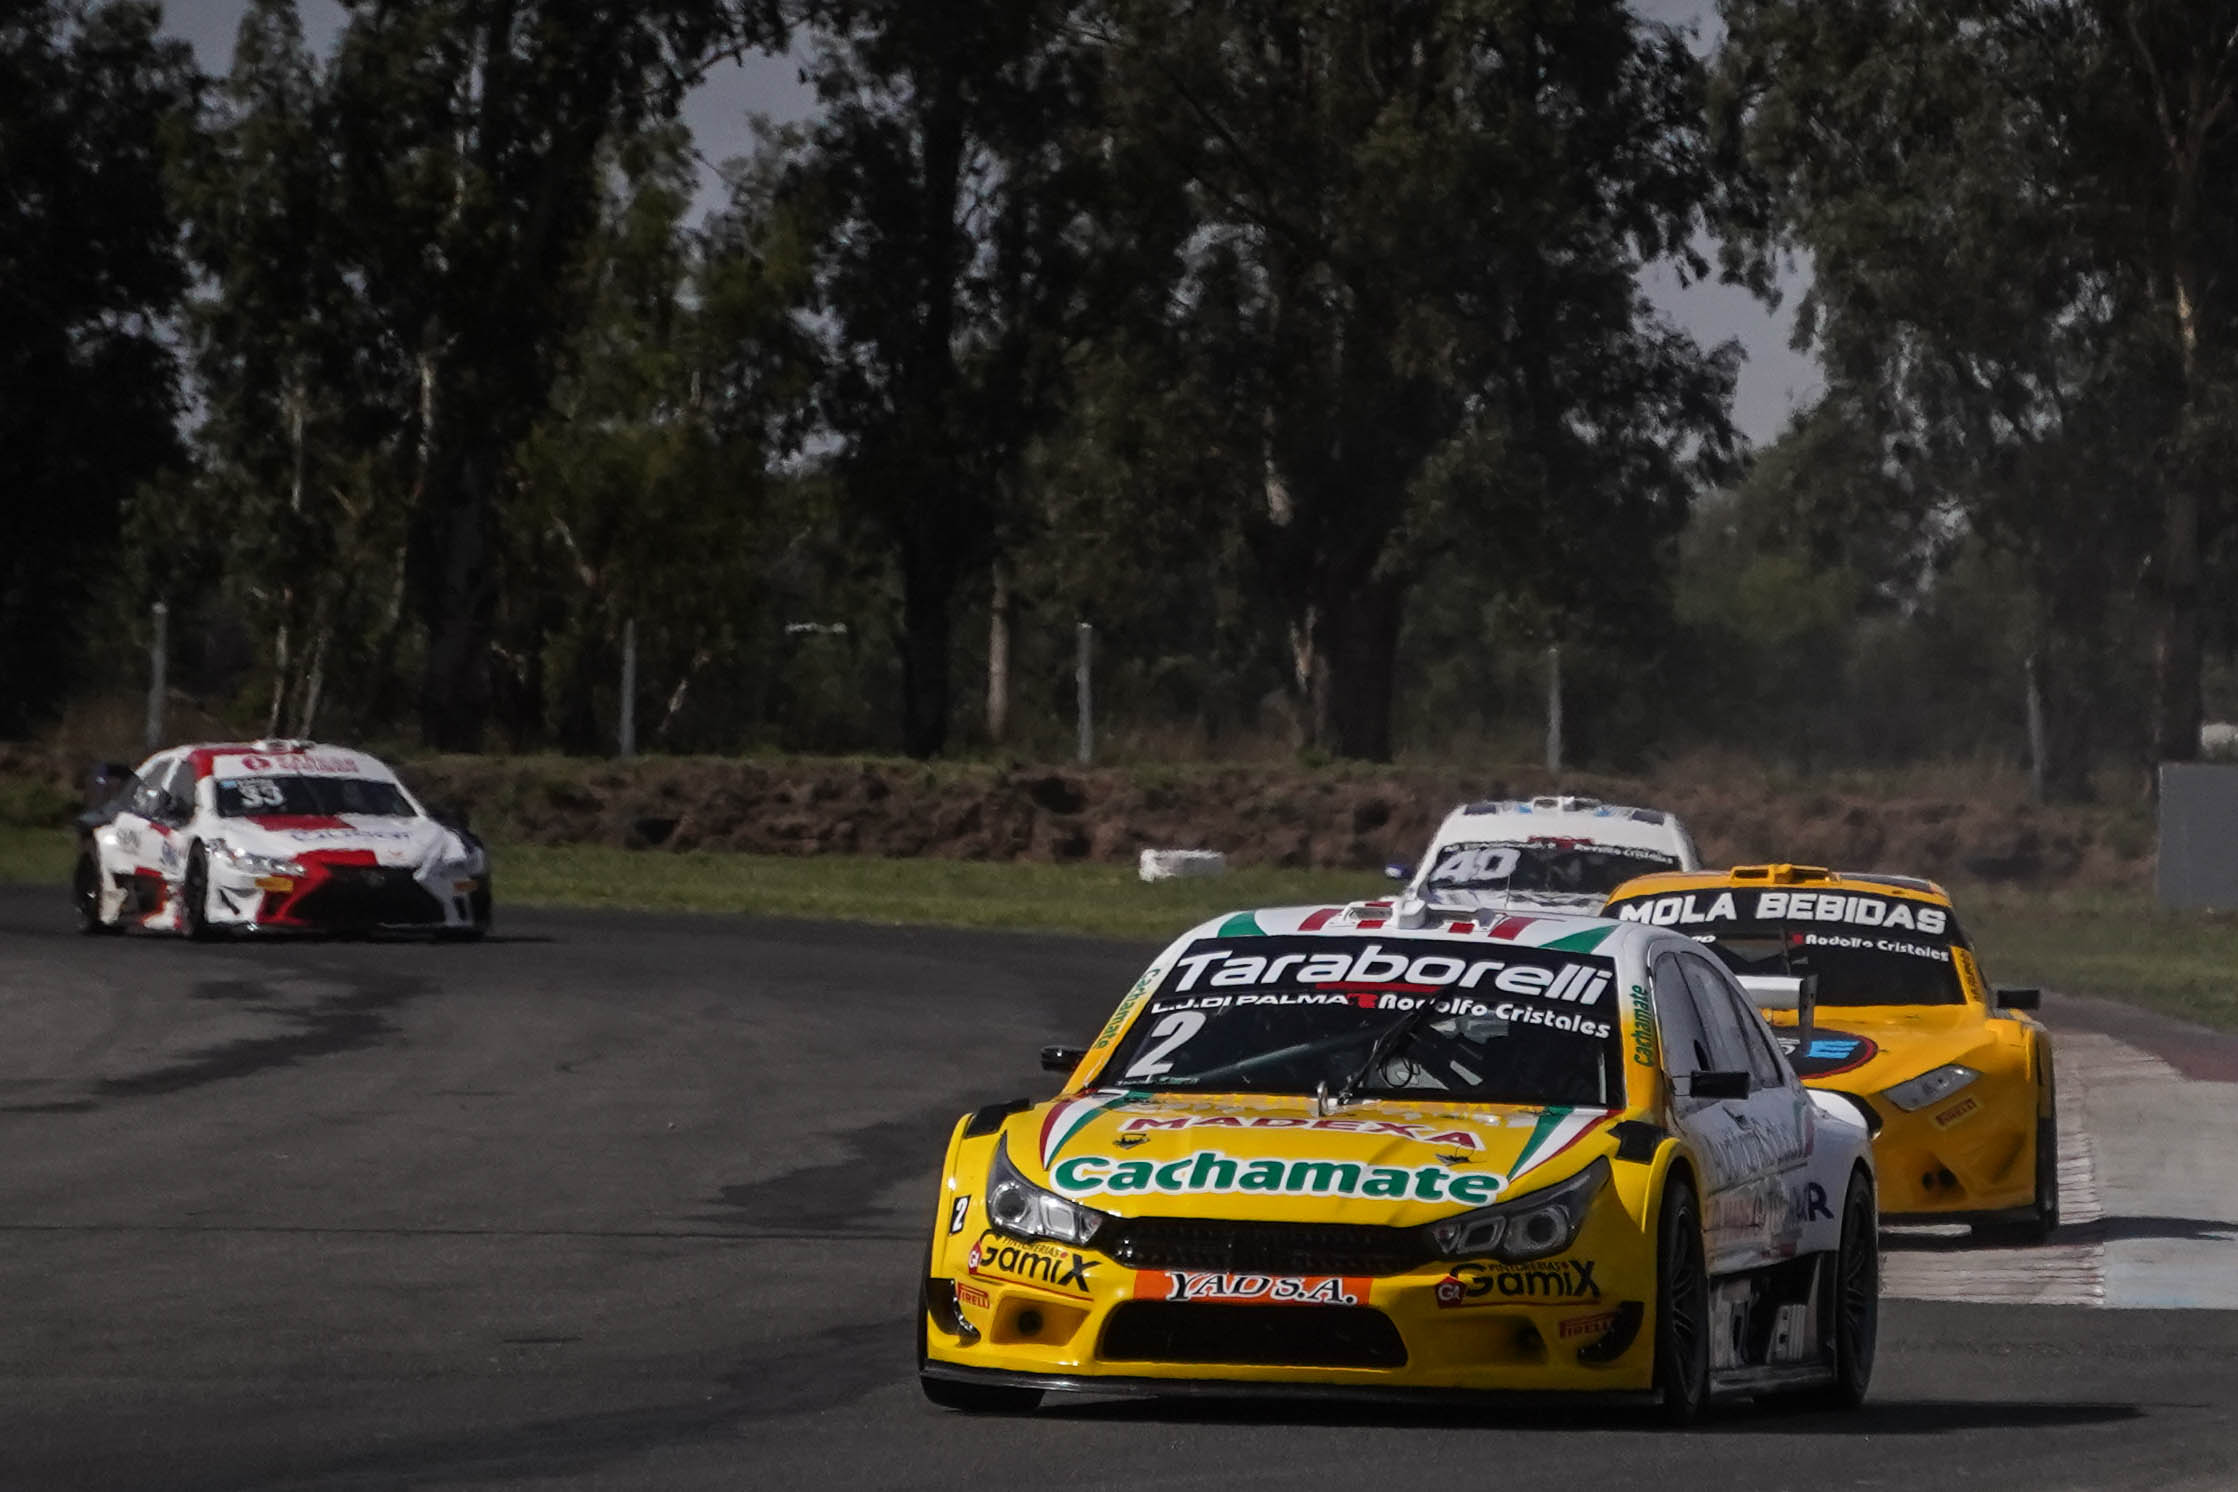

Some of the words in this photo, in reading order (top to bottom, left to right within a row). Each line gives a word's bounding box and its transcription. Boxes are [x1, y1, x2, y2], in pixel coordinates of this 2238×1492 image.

[1430, 846, 1522, 884] 40
[1619, 892, 1738, 927] MOLA
[1756, 892, 1948, 935] BEBIDAS
[1805, 933, 1874, 950] Rodolfo
[1877, 939, 1949, 962] Cristales
[1174, 944, 1613, 1006] Taraborelli
[1096, 967, 1161, 1049] Cachamate
[1235, 993, 1350, 1006] PALMA
[1495, 1003, 1611, 1039] Cristales
[1631, 984, 1653, 1068] Cachamate
[1124, 1010, 1207, 1079] 2
[1122, 1115, 1481, 1150] MADEXA
[1052, 1152, 1501, 1204] Cachamate
[951, 1197, 969, 1233] 2
[957, 1281, 991, 1310] PIRELLI
